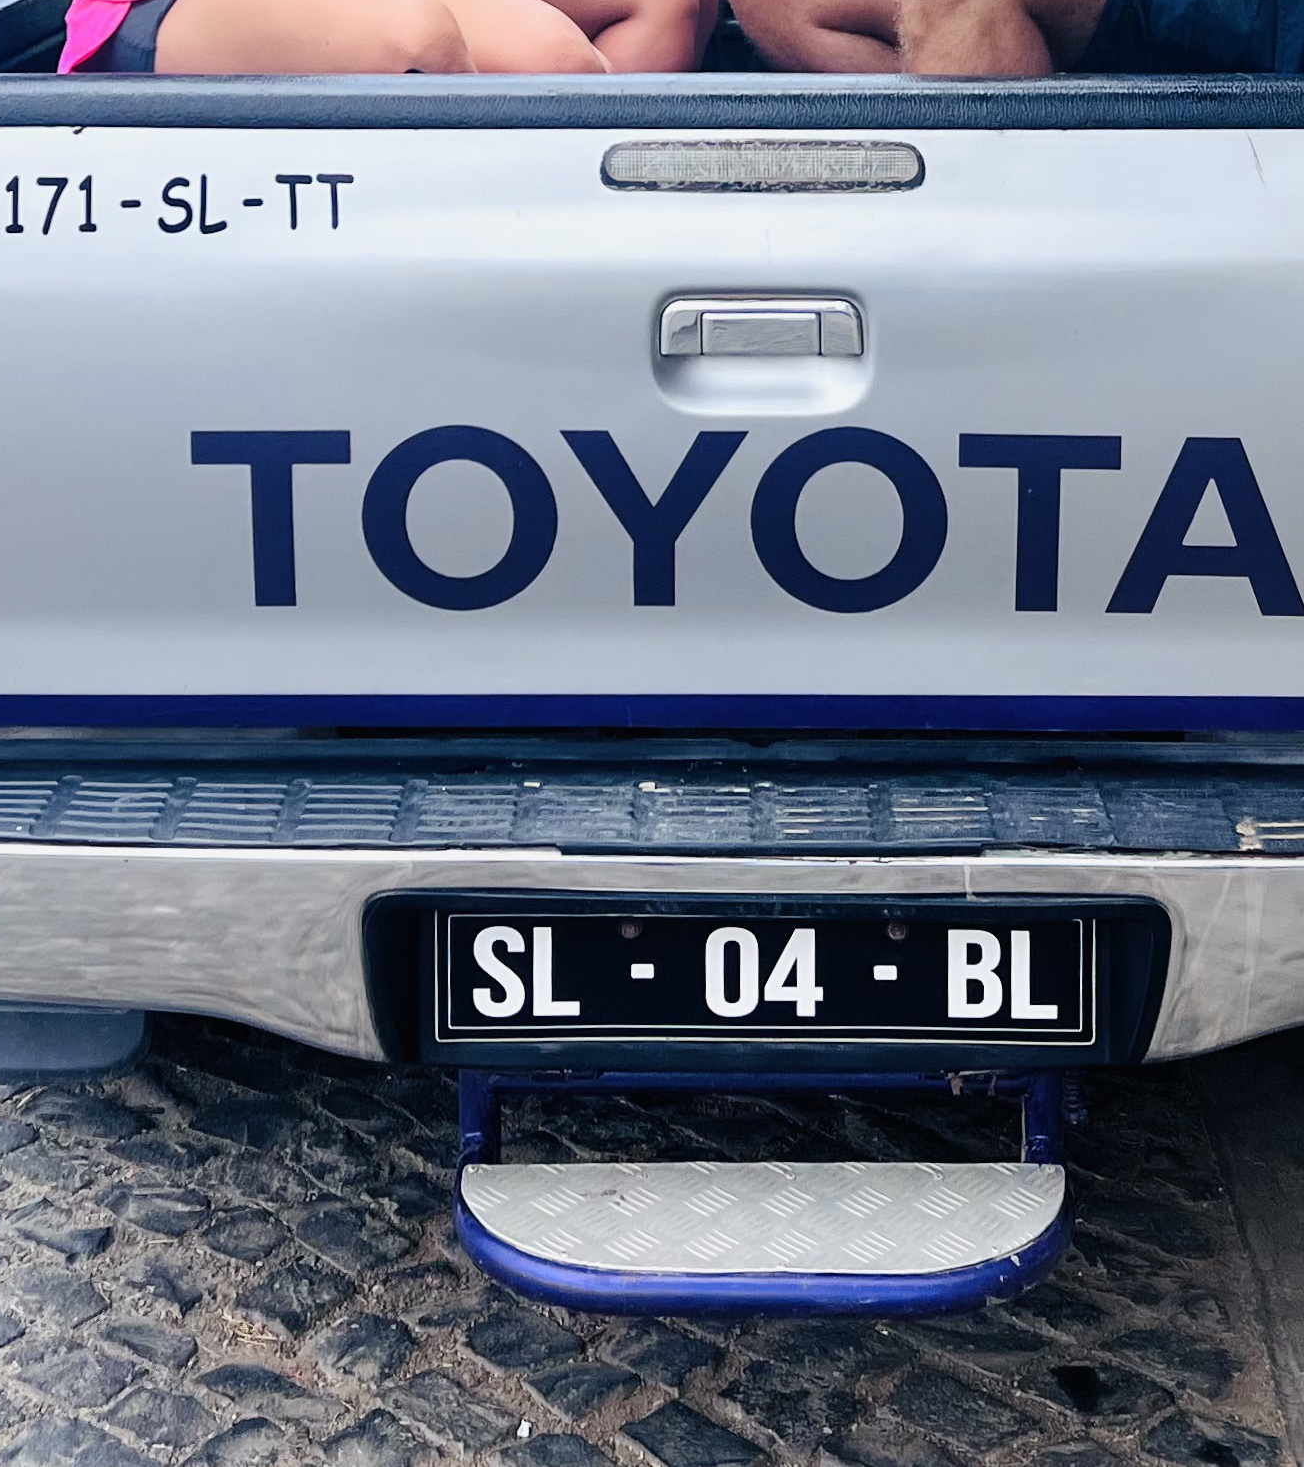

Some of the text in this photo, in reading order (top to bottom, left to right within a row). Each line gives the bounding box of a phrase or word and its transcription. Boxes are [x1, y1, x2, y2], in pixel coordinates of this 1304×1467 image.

[472, 926, 580, 1018] SL
[704, 927, 824, 1018] 04
[948, 930, 1059, 1020] BL
